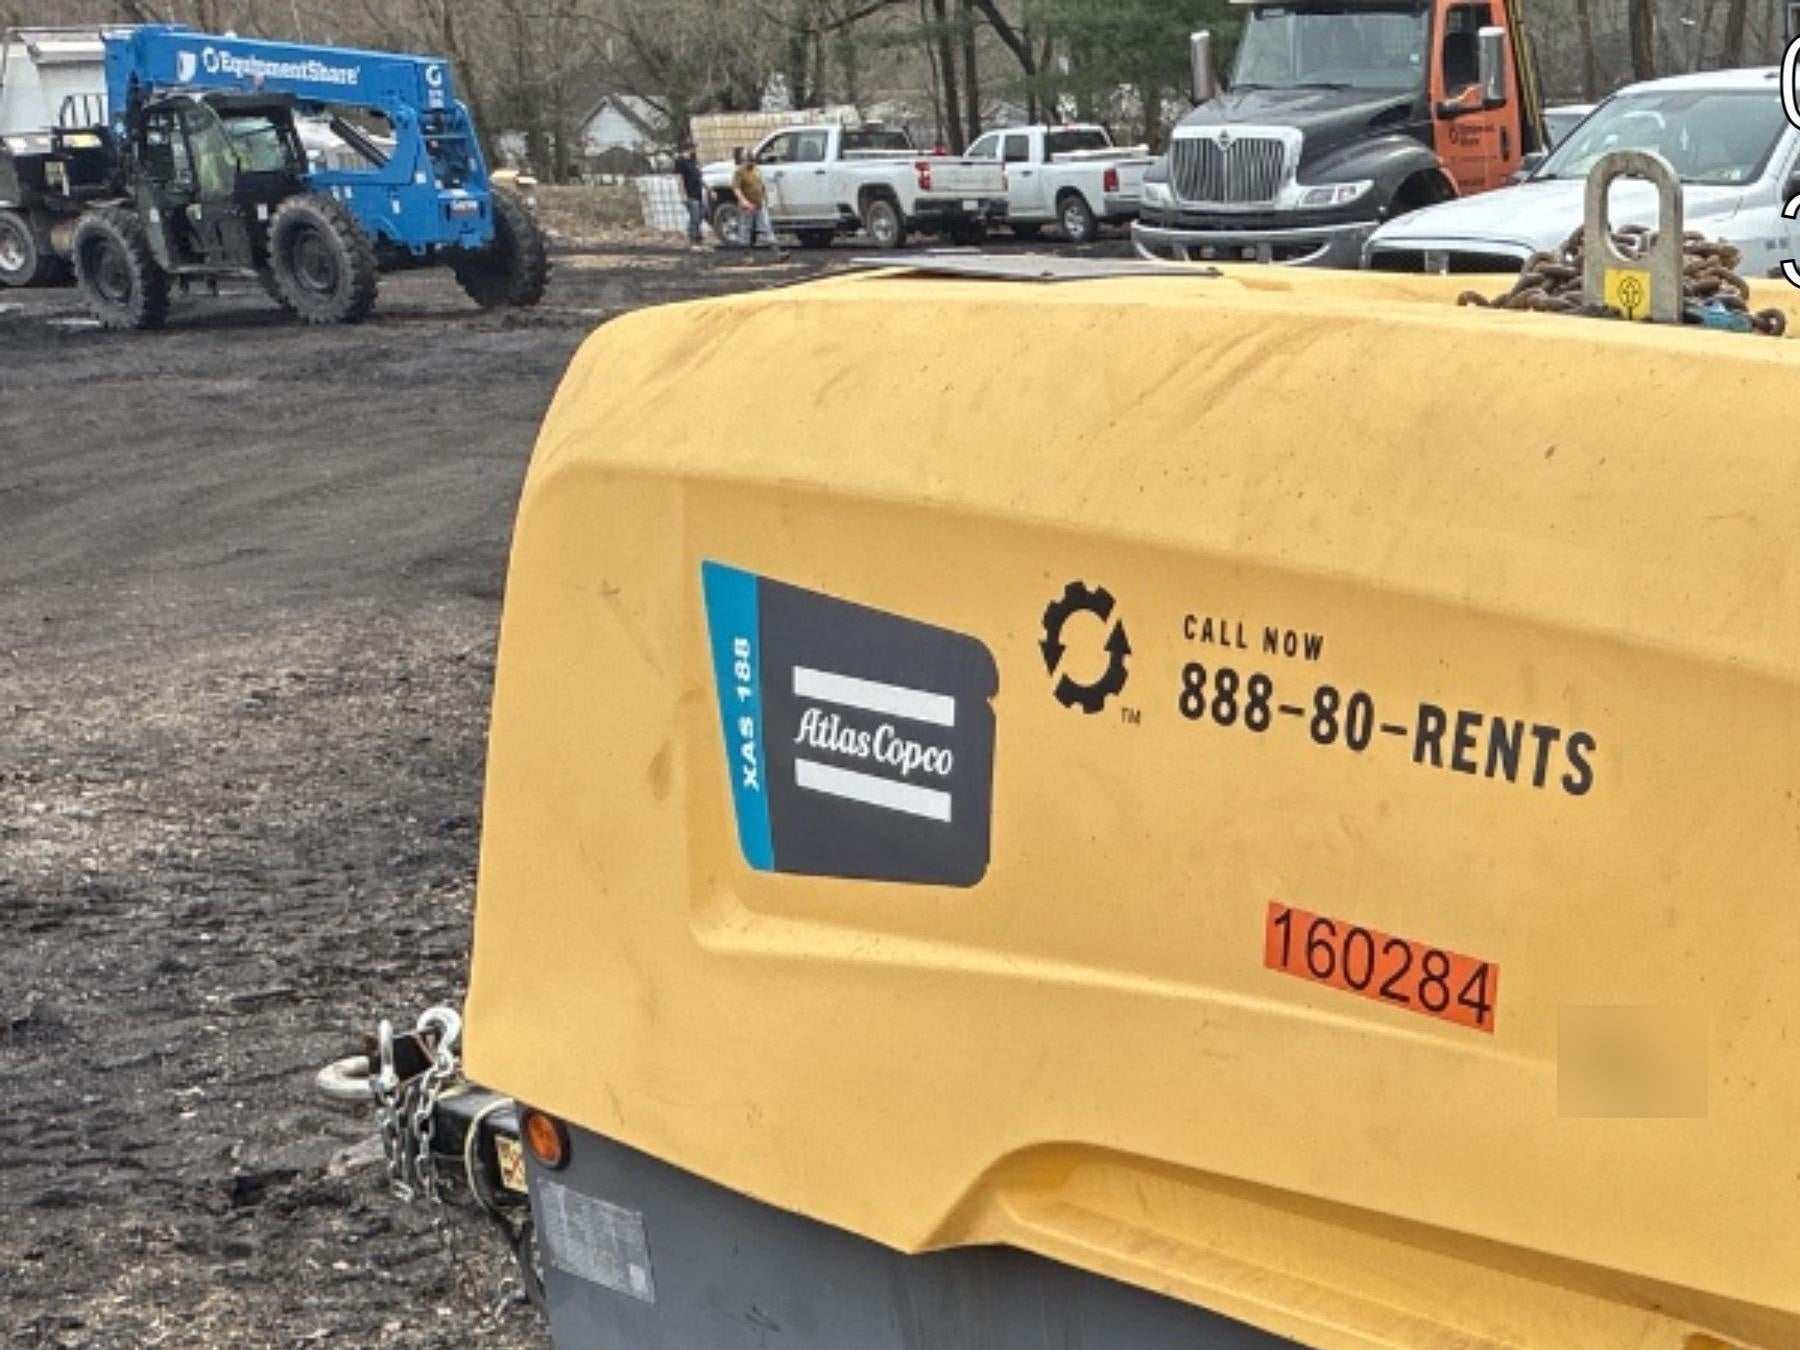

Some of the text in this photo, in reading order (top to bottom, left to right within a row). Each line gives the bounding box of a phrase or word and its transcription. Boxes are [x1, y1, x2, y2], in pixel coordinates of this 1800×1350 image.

[1183, 613, 1325, 662] CALL NOW
[740, 716, 760, 791] XAS
[1273, 908, 1492, 1026] 160284
